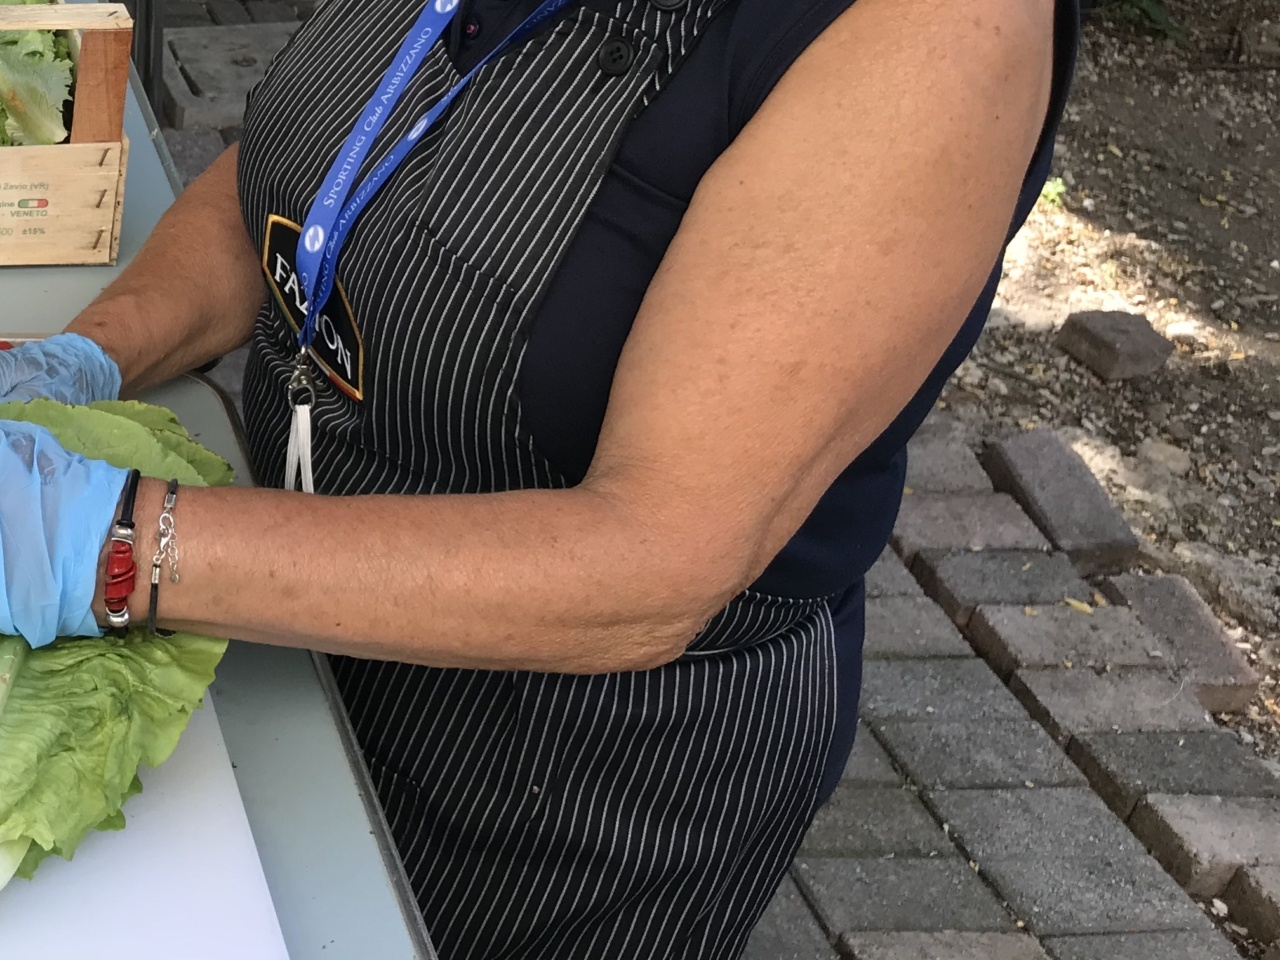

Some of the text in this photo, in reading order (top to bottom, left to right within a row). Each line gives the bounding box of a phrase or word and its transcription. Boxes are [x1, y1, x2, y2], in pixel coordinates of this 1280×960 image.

[323, 27, 432, 208] SPORTING Club ARBIZZANO
[10, 209, 48, 218] VENETO
[339, 154, 394, 230] ARBIZZANO
